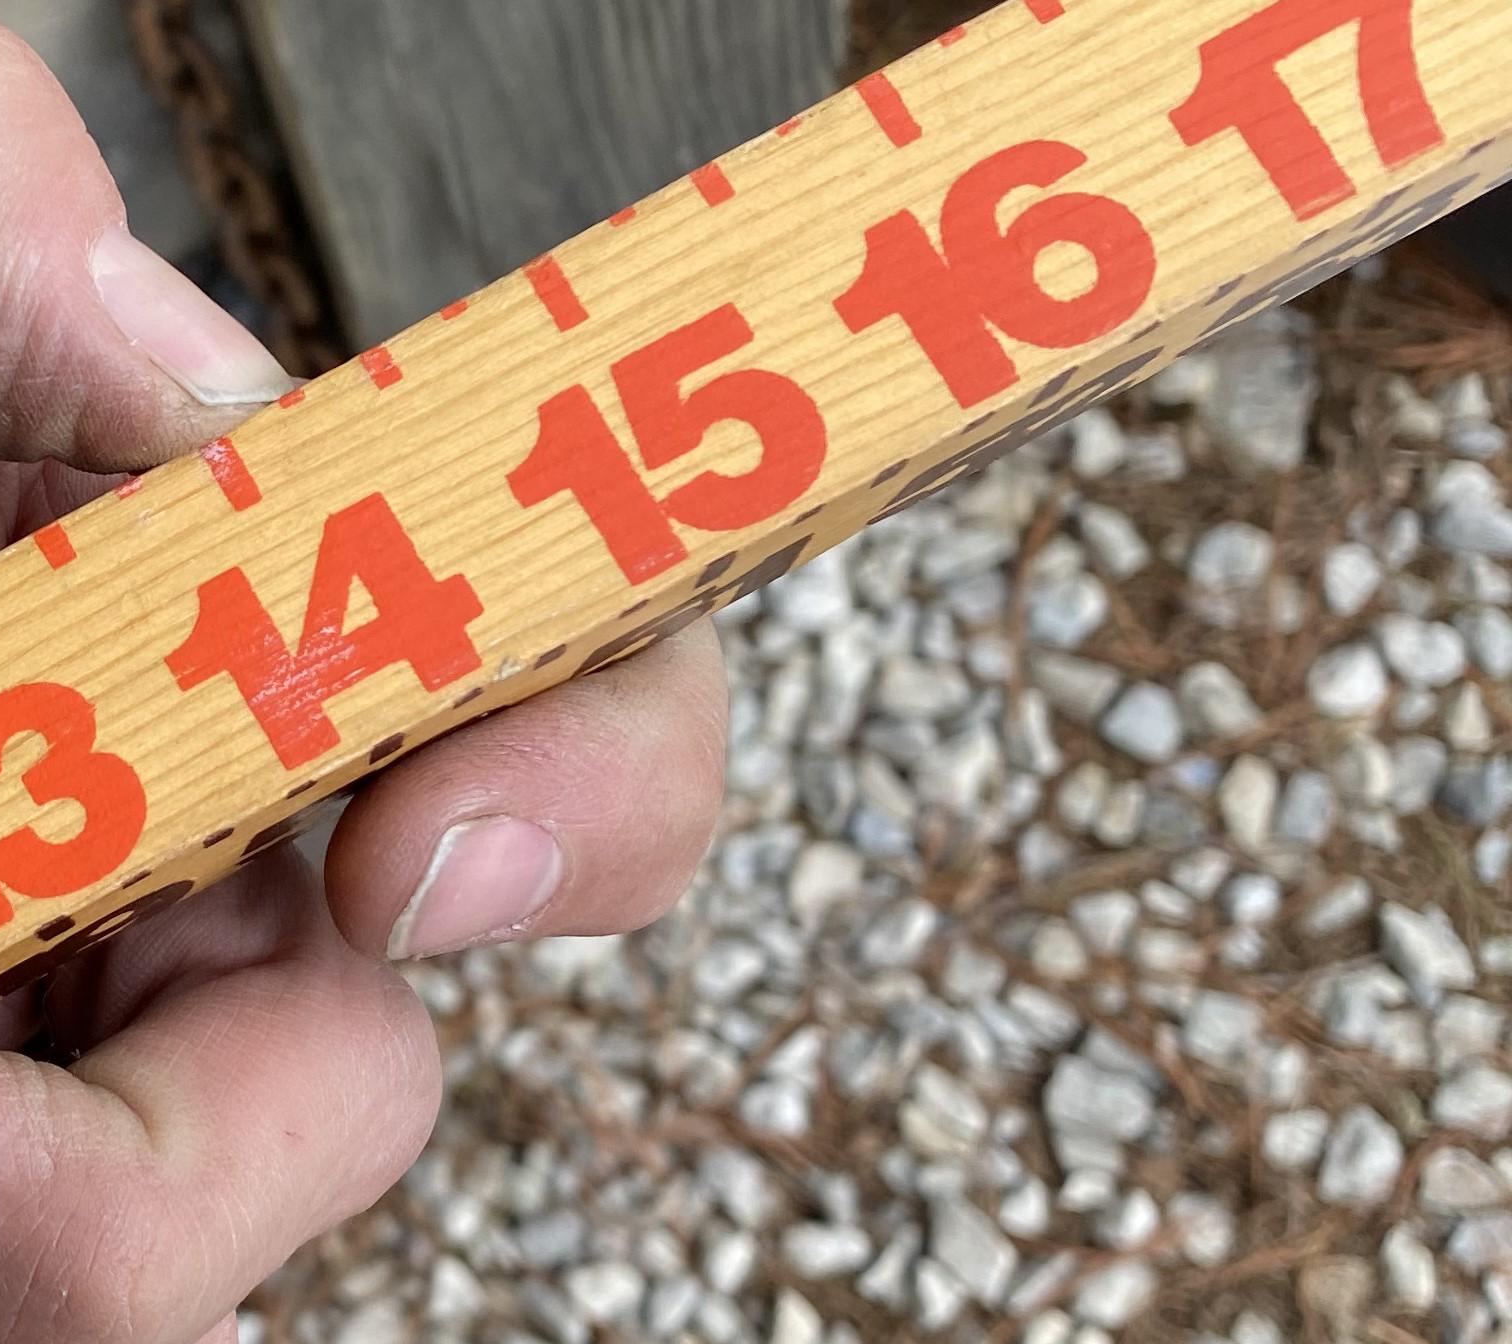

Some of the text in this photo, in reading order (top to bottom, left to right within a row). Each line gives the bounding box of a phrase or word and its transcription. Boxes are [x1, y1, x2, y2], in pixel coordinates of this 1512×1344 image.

[165, 493, 483, 769] 14
[507, 303, 827, 586] 15
[834, 140, 1157, 409] 16
